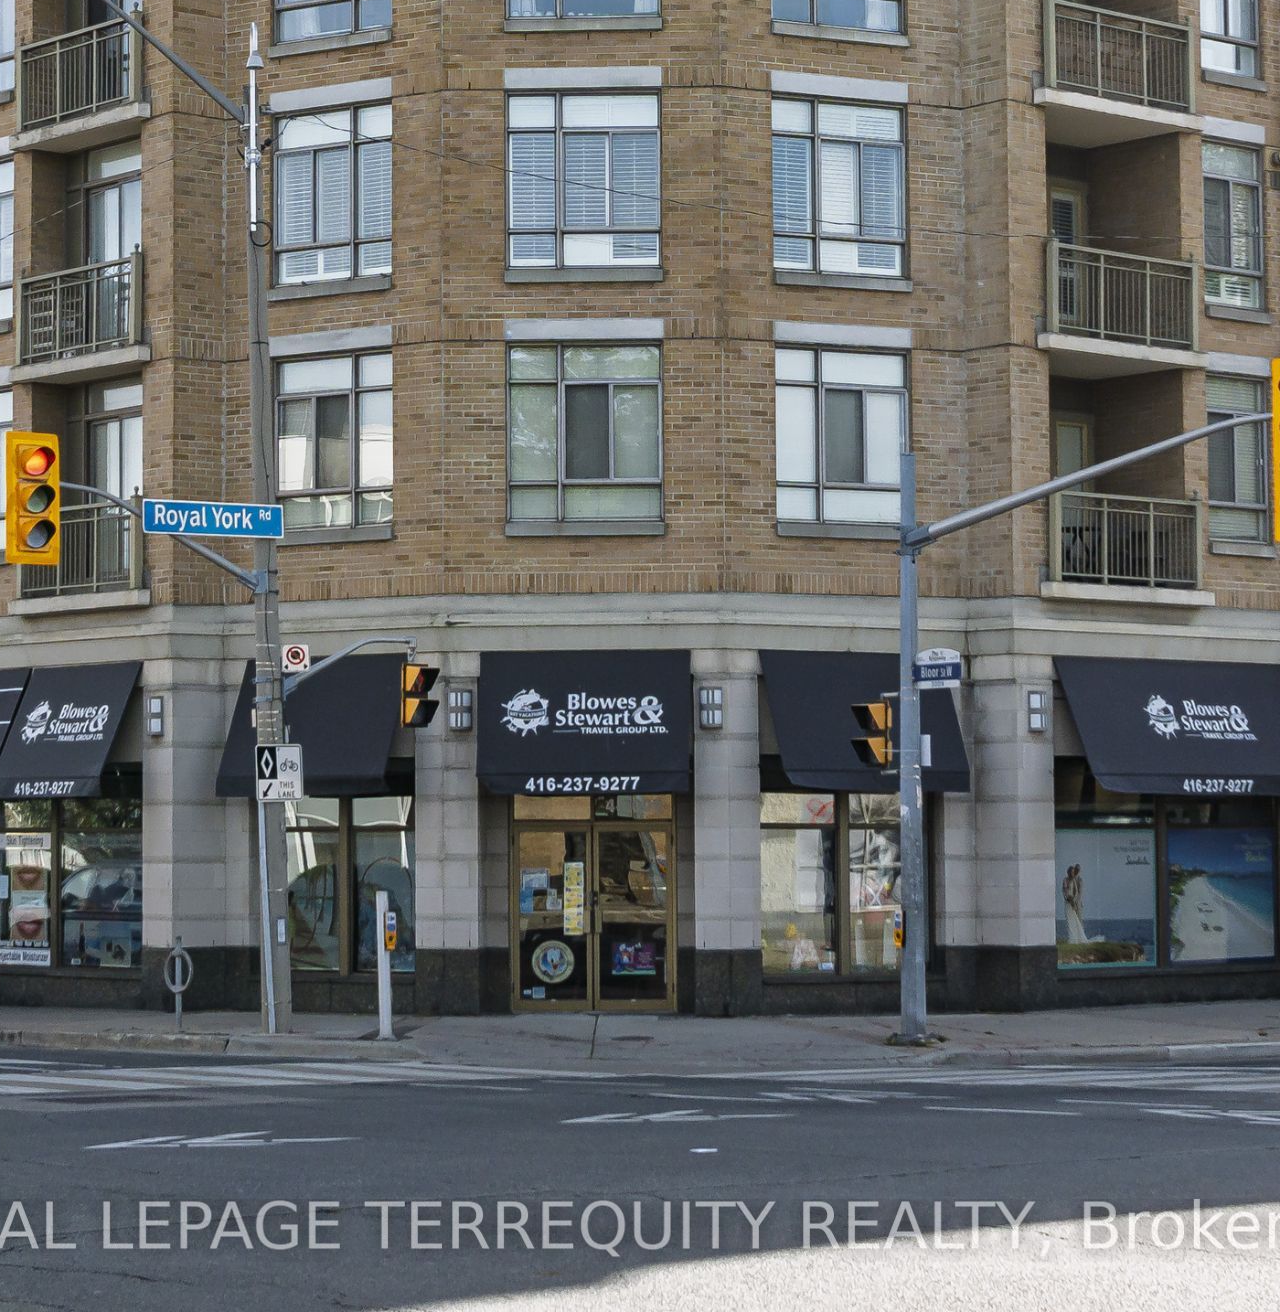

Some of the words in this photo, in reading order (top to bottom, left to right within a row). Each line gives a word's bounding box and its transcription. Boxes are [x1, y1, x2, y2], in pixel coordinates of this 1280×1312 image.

[154, 504, 207, 532] Royal
[211, 506, 253, 530] York
[259, 509, 271, 520] Rd
[921, 666, 939, 678] Bloor
[946, 665, 952, 676] W
[568, 692, 637, 710] Blowes
[632, 696, 664, 725] &
[1182, 699, 1230, 717] Blowes
[1229, 705, 1250, 731] &
[59, 703, 98, 719] Blowes
[89, 705, 109, 733] &
[555, 709, 631, 726] Stewart
[1181, 715, 1231, 731] Stewart
[47, 719, 89, 734] Stewart
[616, 726, 647, 734] GROUP
[14, 781, 75, 796] 416-237-9277
[280, 781, 294, 789] THIS
[525, 776, 640, 792] 416-237-9277
[1183, 778, 1254, 792] 416-237-9277
[277, 790, 296, 798] LANE
